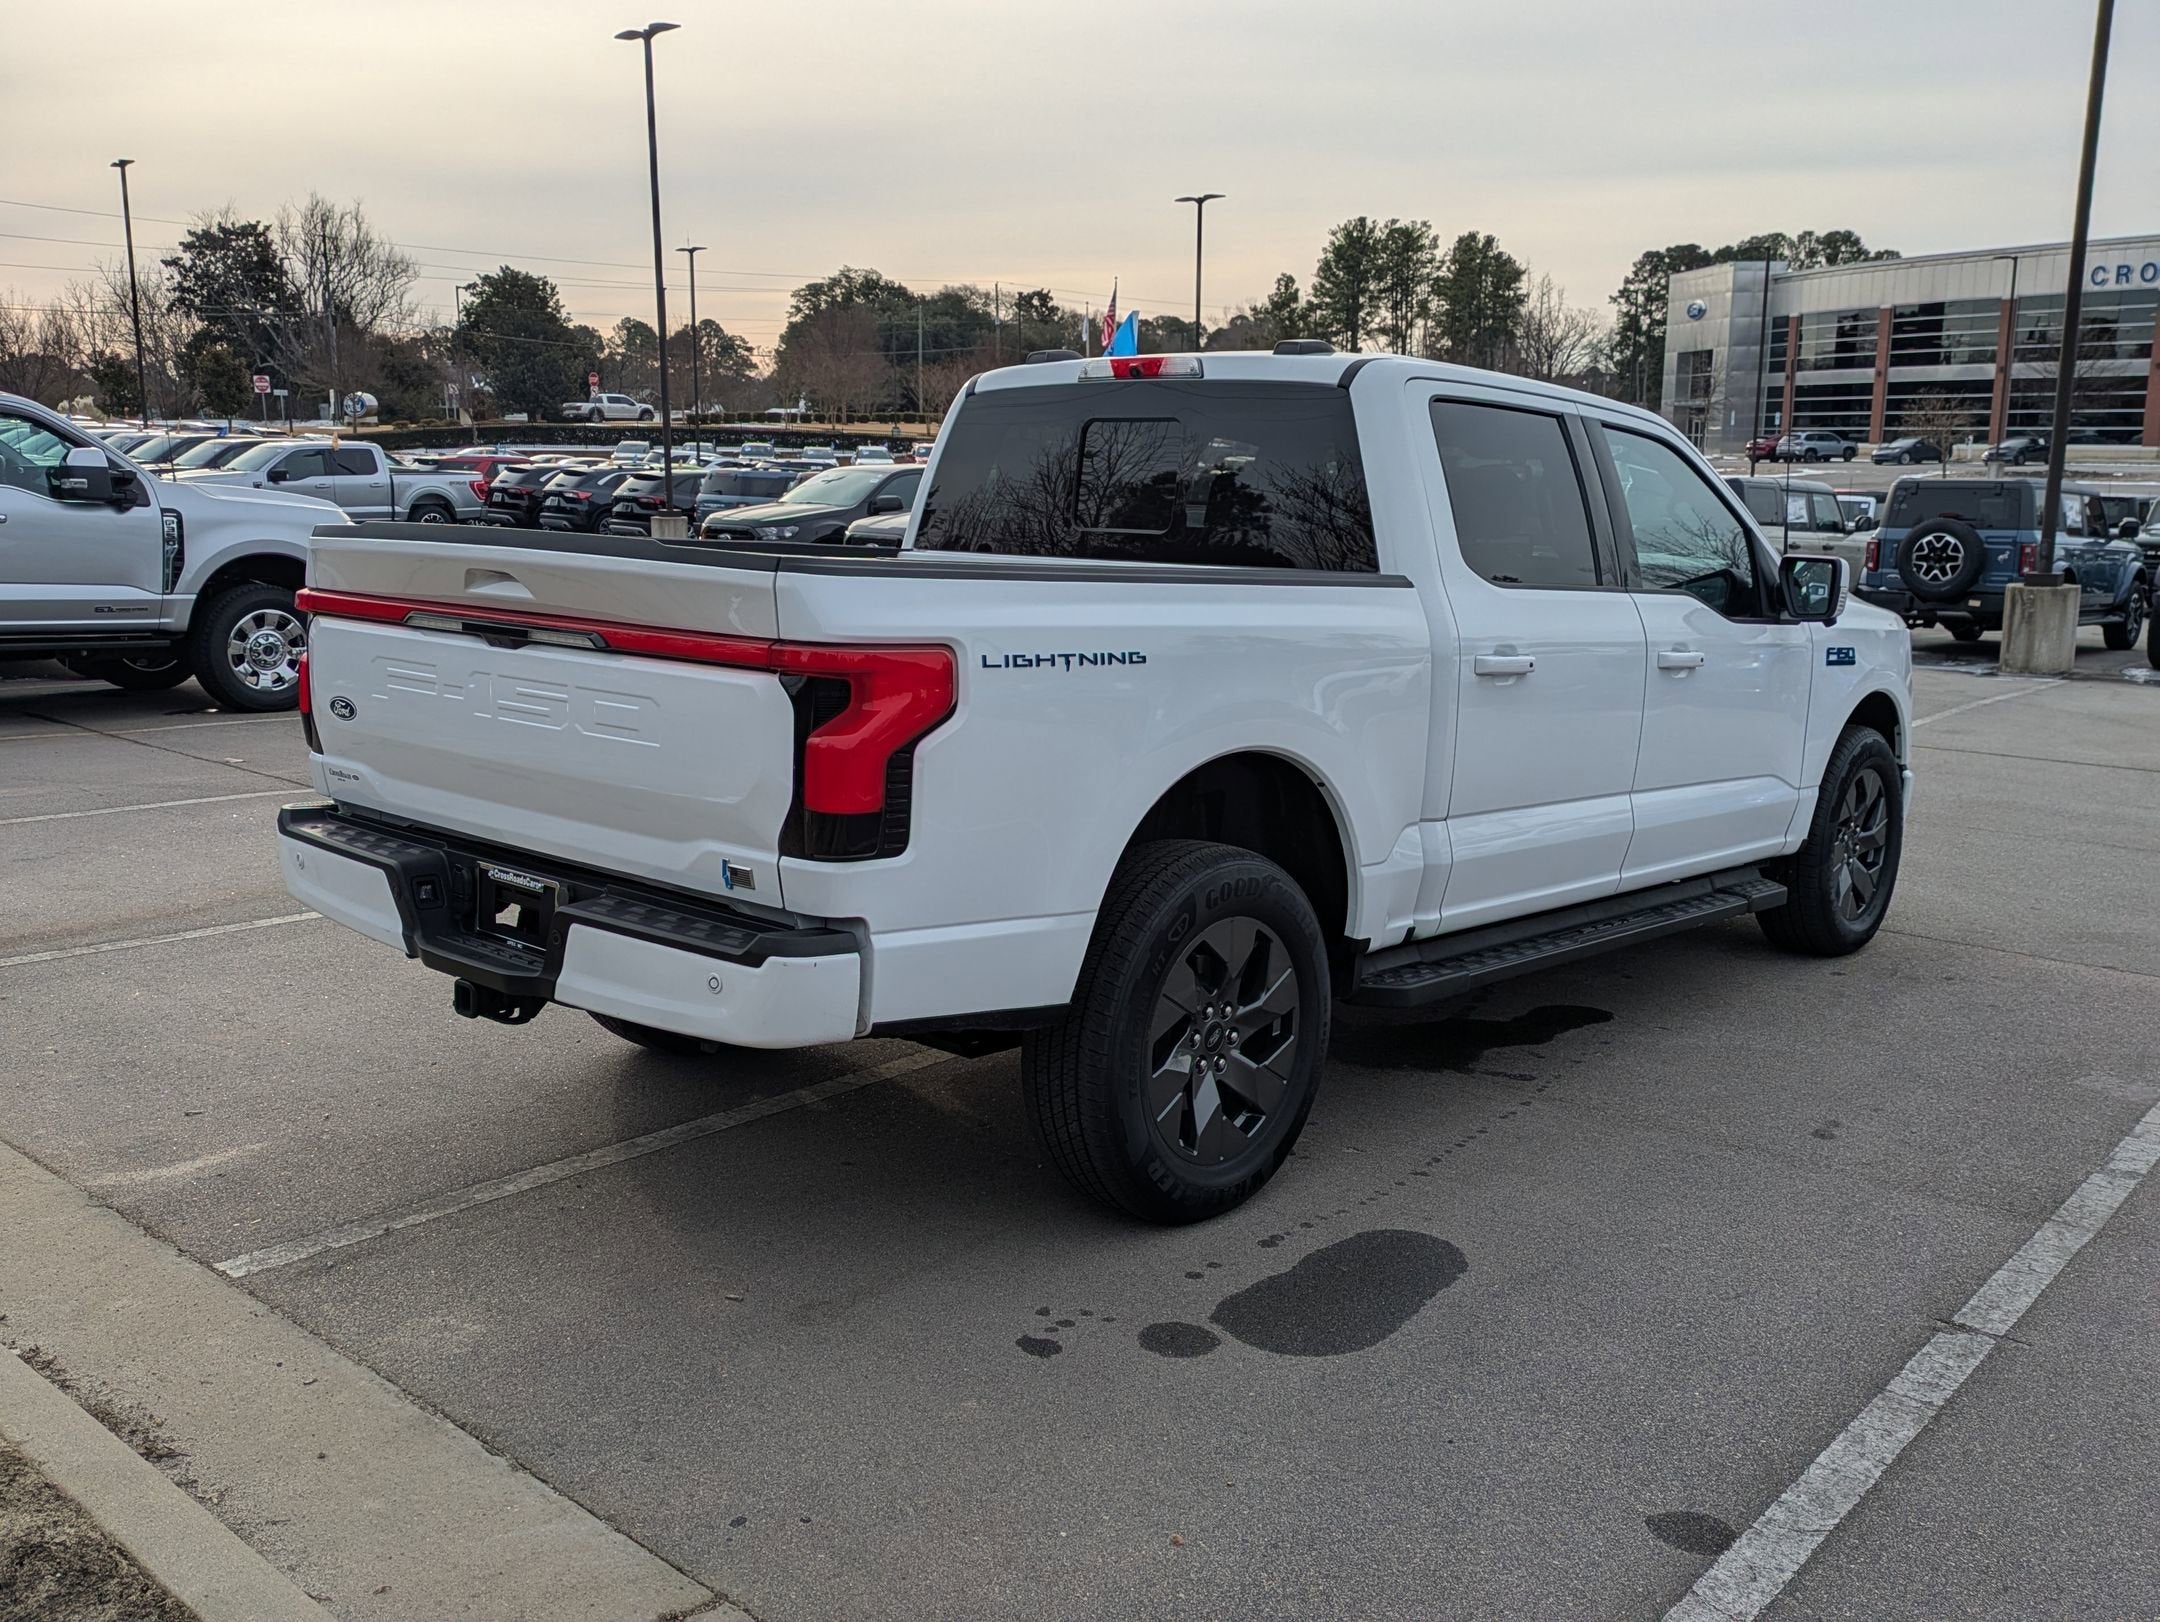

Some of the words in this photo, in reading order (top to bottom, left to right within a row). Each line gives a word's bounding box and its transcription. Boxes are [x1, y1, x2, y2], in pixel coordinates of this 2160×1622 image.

[2091, 262, 2158, 286] CRO
[982, 651, 1147, 672] LIGHTNING
[333, 700, 351, 717] Ford
[371, 655, 661, 748] F-150
